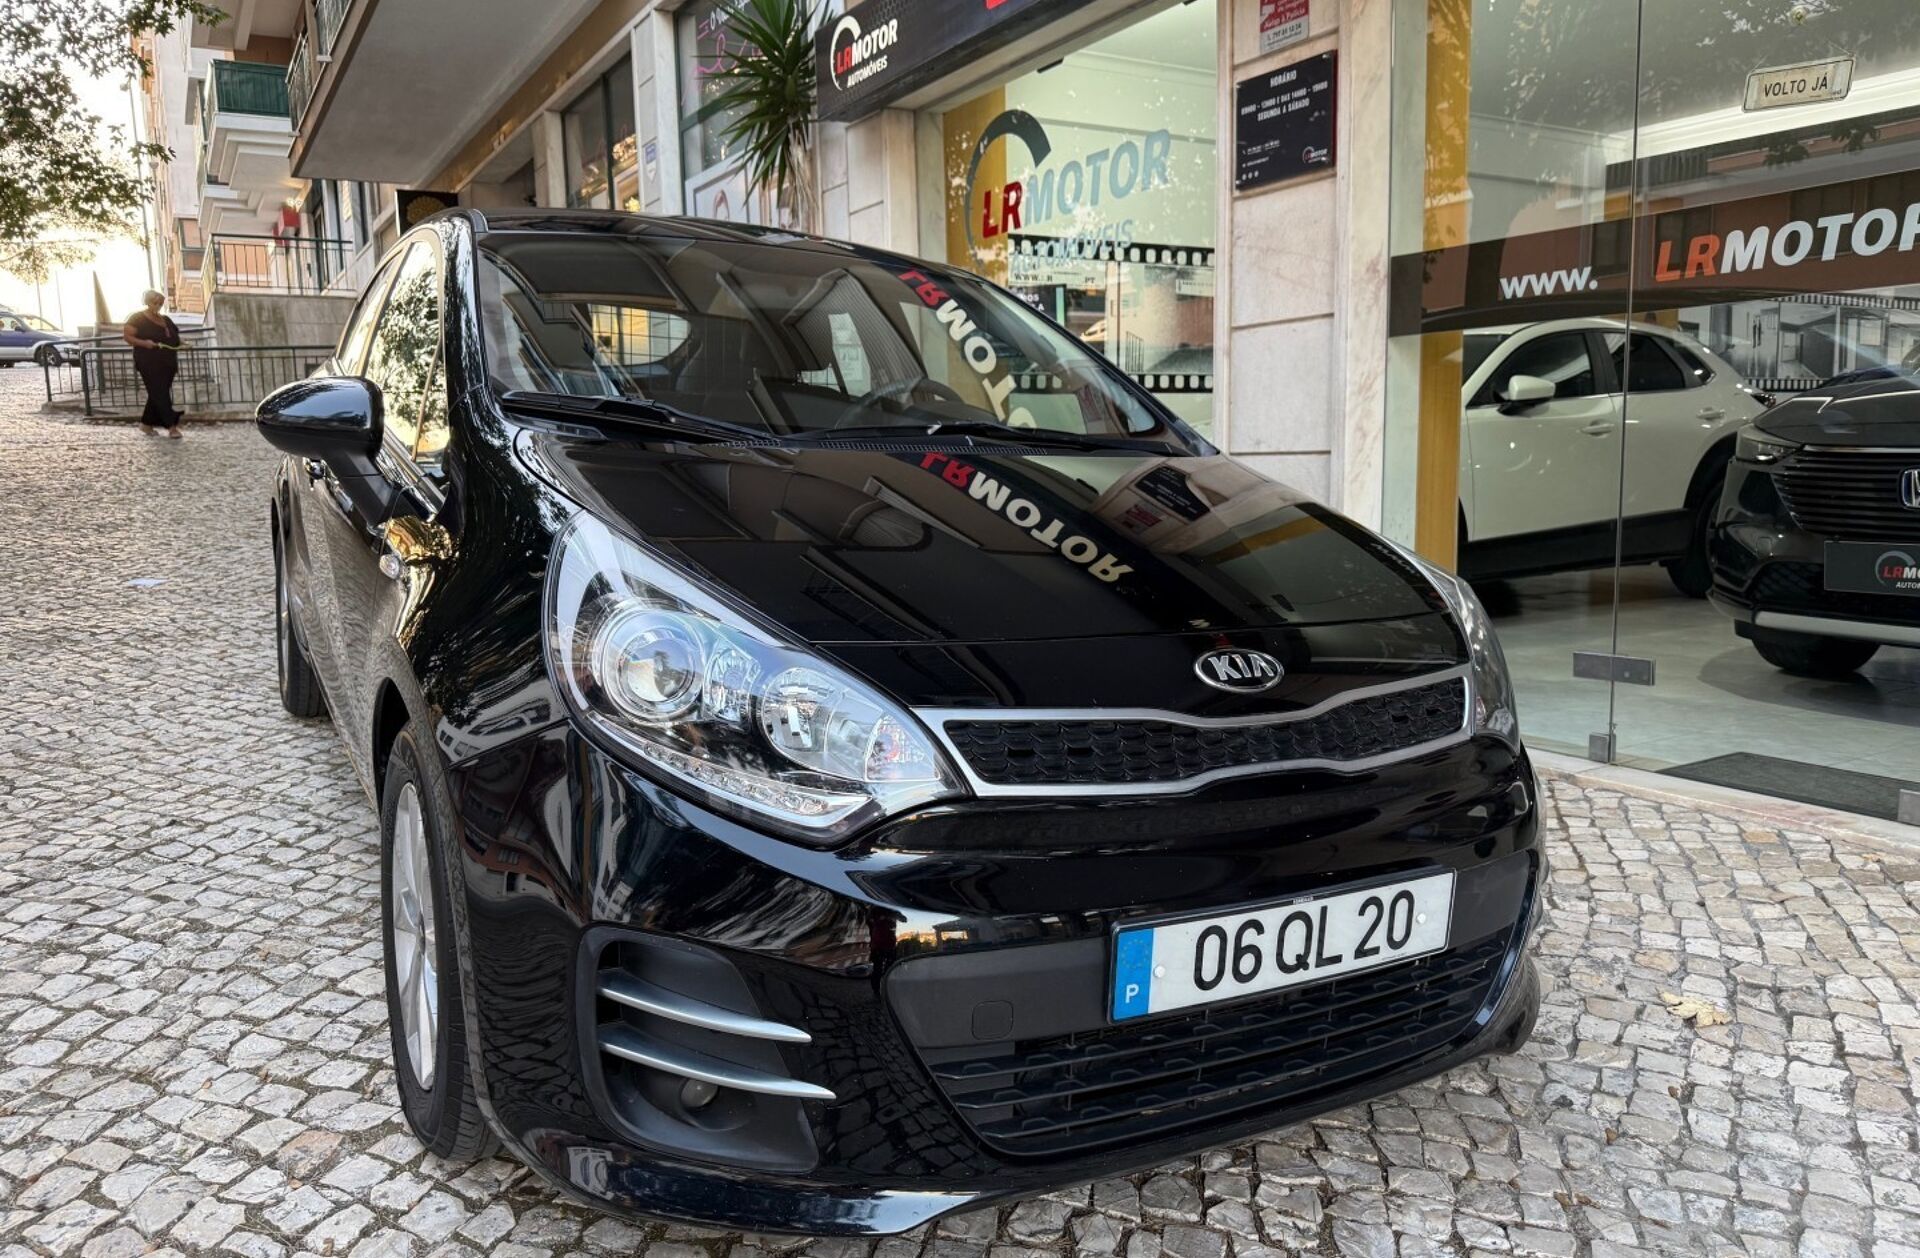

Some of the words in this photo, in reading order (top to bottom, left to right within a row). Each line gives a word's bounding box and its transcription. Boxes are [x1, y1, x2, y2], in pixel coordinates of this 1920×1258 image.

[836, 18, 898, 75] LRMOTOR
[846, 55, 888, 89] AUTOMÓVEIS
[1269, 69, 1297, 88] HORÁRIO
[1764, 79, 1806, 97] VOLTO
[1811, 72, 1828, 91] JÁ
[1257, 106, 1281, 122] SEGUNDA
[1288, 97, 1310, 111] SÁBADO
[982, 129, 1171, 239] LRMOTOR
[1499, 266, 1598, 300] www.
[1207, 653, 1275, 681] KIA
[1193, 918, 1265, 991] 06
[1275, 905, 1343, 974] QL
[1354, 889, 1416, 961] 20
[1125, 983, 1140, 1004] P
